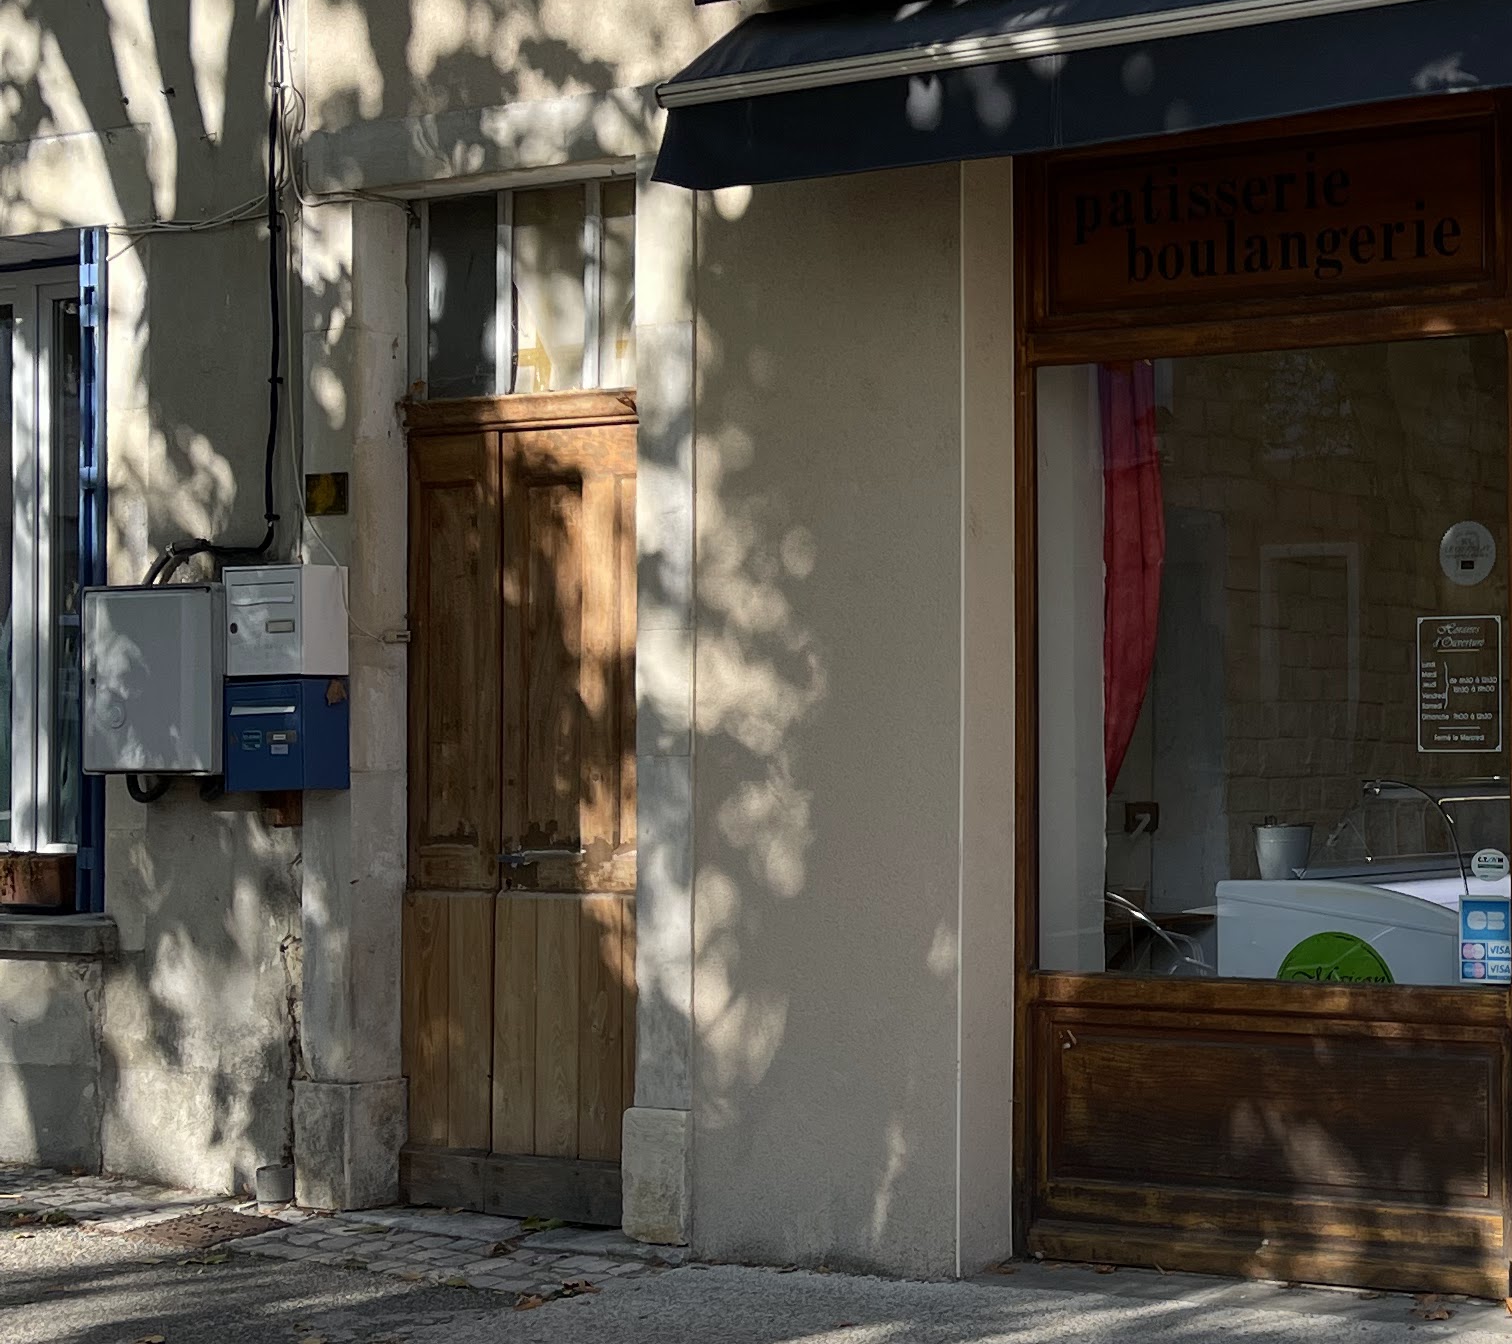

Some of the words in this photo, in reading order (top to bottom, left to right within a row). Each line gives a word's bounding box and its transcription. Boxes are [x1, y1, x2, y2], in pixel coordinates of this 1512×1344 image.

[1073, 153, 1353, 246] patisserie
[1126, 199, 1464, 284] boulangerie
[1490, 945, 1511, 956] VISA
[1490, 964, 1511, 975] VISA
